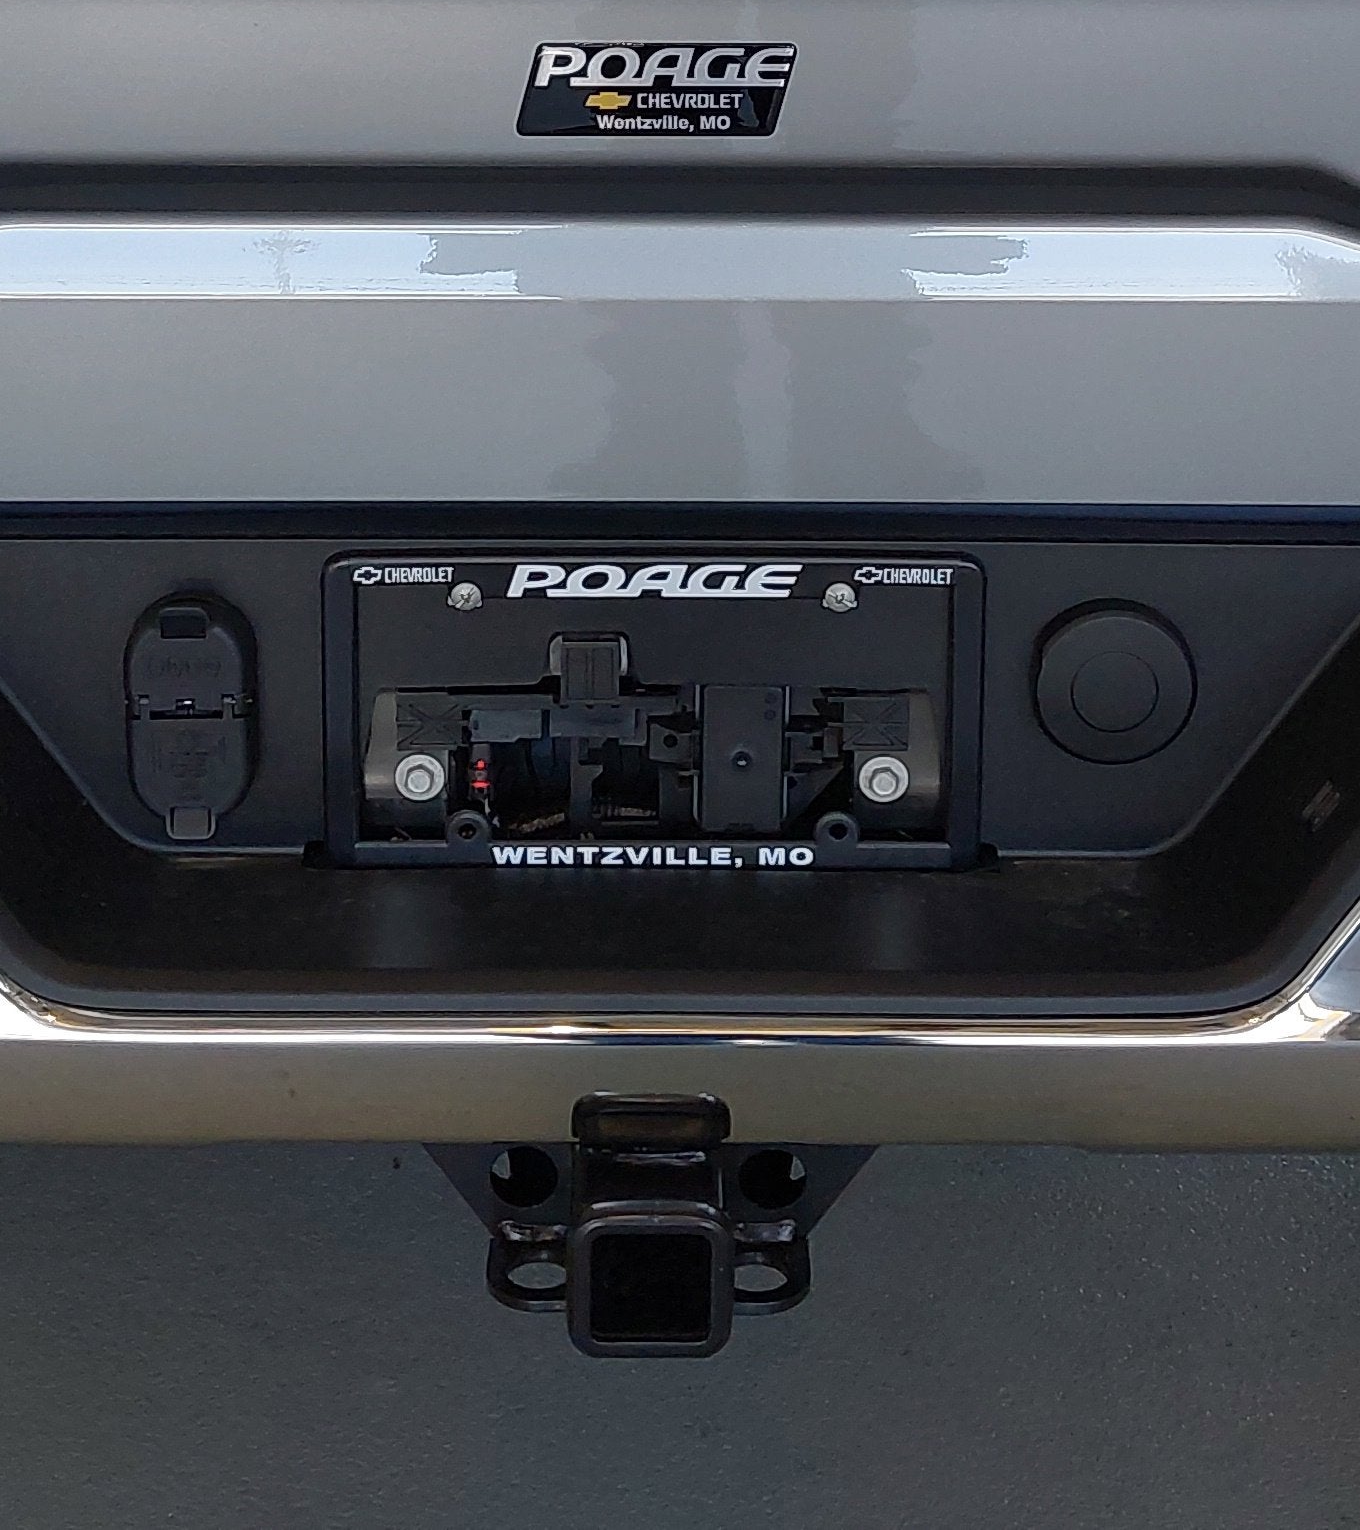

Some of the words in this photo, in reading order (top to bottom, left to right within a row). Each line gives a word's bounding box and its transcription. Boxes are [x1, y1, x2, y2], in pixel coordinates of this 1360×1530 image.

[534, 46, 794, 87] POAGE
[636, 93, 743, 109] CHEVROLET
[596, 114, 694, 133] Wentzville,
[700, 115, 731, 130] MO
[384, 567, 454, 583] CHEVROLET
[506, 564, 803, 598] POAGE
[883, 568, 954, 585] CHEVROLET
[492, 845, 744, 868] WENTZVILLE,
[758, 845, 815, 866] MO
